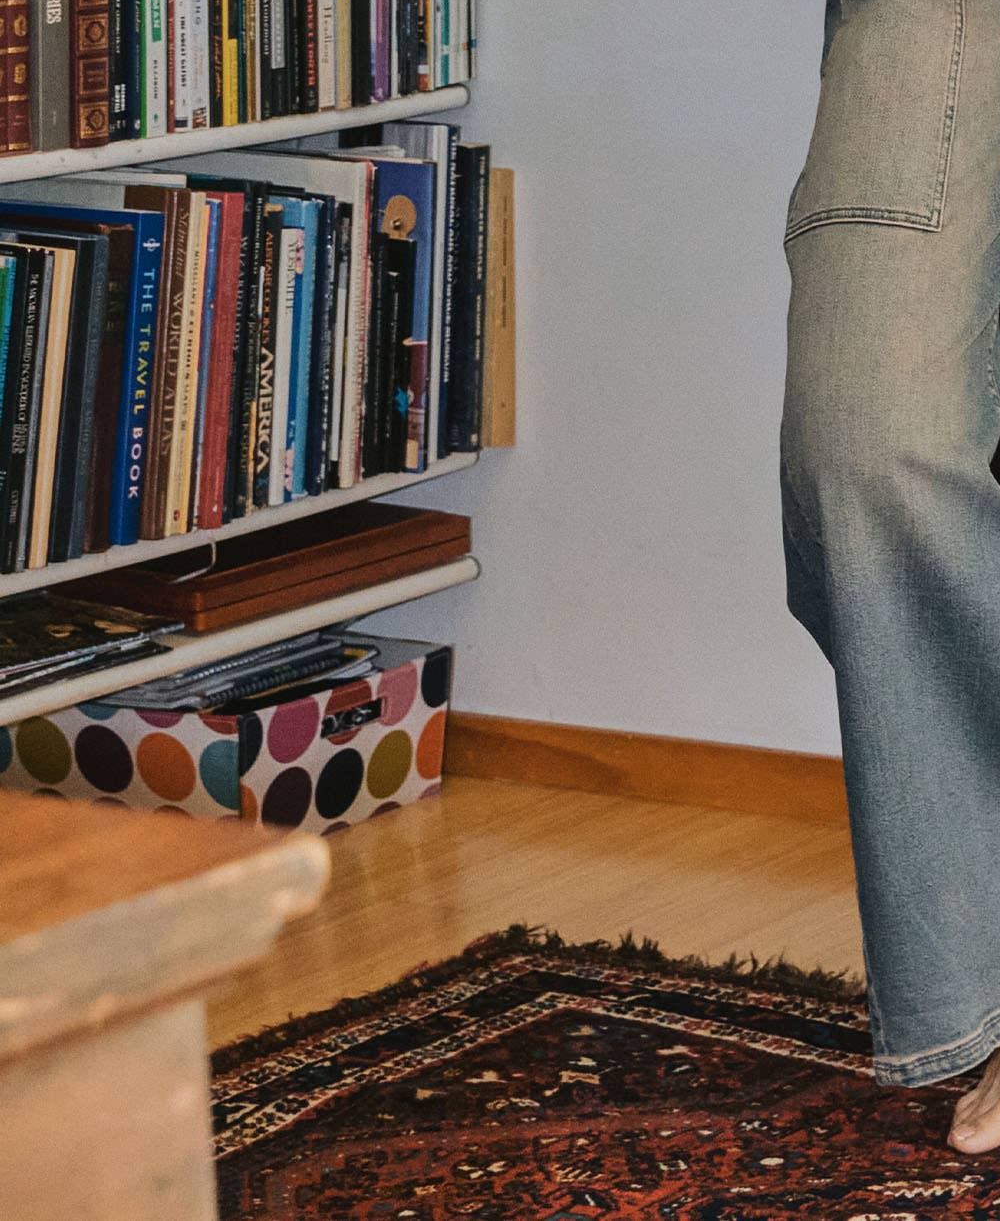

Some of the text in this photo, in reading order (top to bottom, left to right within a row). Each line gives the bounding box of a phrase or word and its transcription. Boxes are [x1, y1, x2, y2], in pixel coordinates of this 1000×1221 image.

[321, 6, 332, 64] Headlong
[264, 231, 274, 287] ALISTAIR
[285, 240, 298, 315] YOSEMITE
[167, 292, 185, 376] WORLD
[127, 267, 156, 499] THE TRAVEL BOOK
[256, 346, 275, 474] AMERICA
[161, 386, 176, 457] ATLAS
